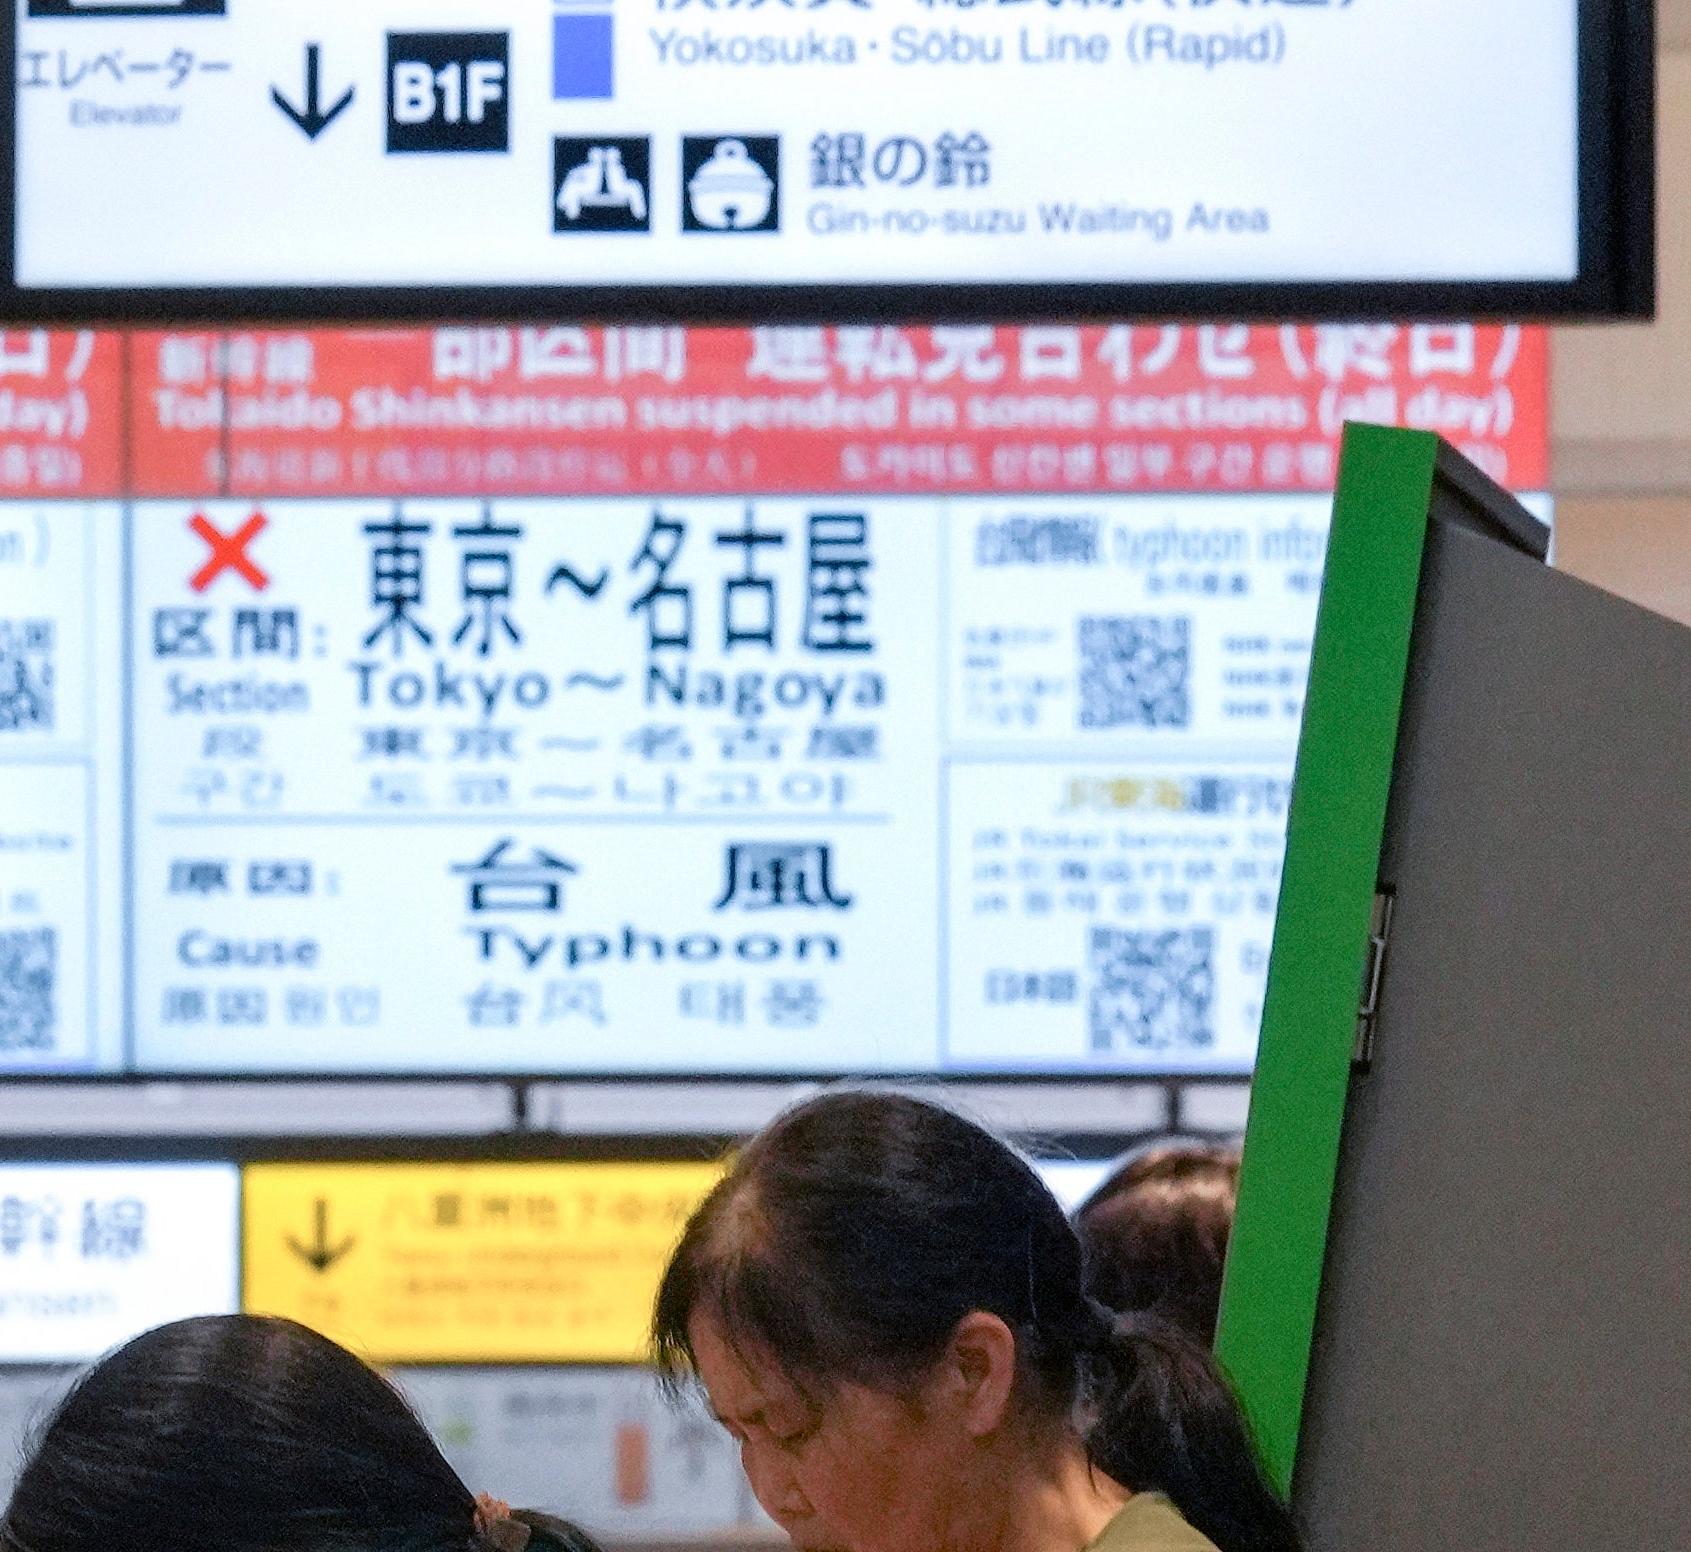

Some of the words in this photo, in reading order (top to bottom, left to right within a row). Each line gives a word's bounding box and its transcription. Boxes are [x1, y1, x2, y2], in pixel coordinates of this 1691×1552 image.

[1019, 22, 1109, 65] Line
[1125, 20, 1288, 69] (Rapid)
[19, 46, 231, 90] エレベーター
[69, 102, 182, 127] Elevator
[393, 60, 505, 125] B1F
[810, 131, 991, 190] 銀の鈴
[806, 201, 1026, 235] Gin-no-suzu
[1038, 201, 1173, 241] Waiting
[1186, 201, 1269, 235] Area
[350, 387, 628, 431] Shinkansen
[910, 388, 959, 428] in
[164, 671, 311, 716] Section
[177, 928, 318, 968] Cause
[462, 924, 843, 970] Typhoon
